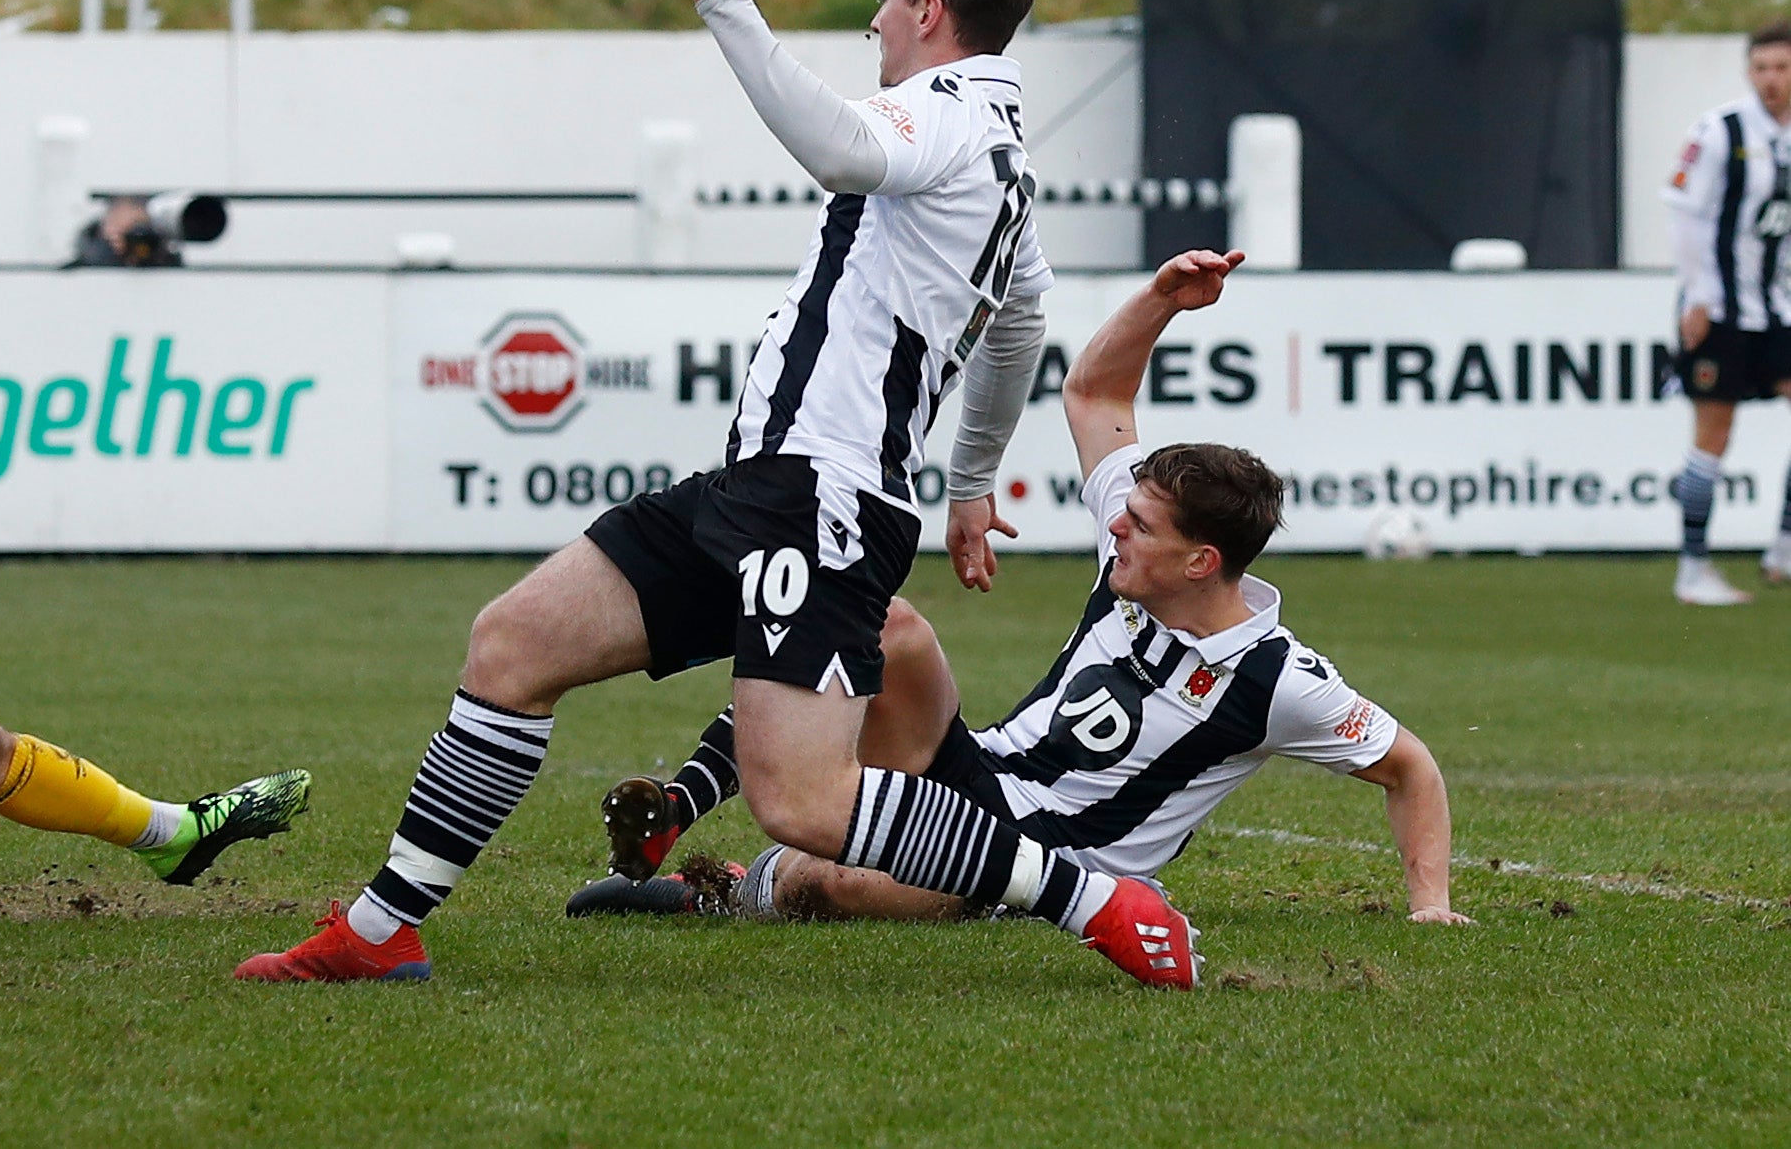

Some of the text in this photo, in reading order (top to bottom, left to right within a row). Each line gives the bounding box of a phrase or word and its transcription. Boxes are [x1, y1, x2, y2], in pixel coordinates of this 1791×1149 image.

[422, 356, 477, 391] ONE
[493, 351, 572, 393] STOP
[586, 357, 650, 391] HIRE
[446, 461, 498, 506] T:
[738, 547, 809, 617] 10
[1061, 686, 1131, 753] JD
